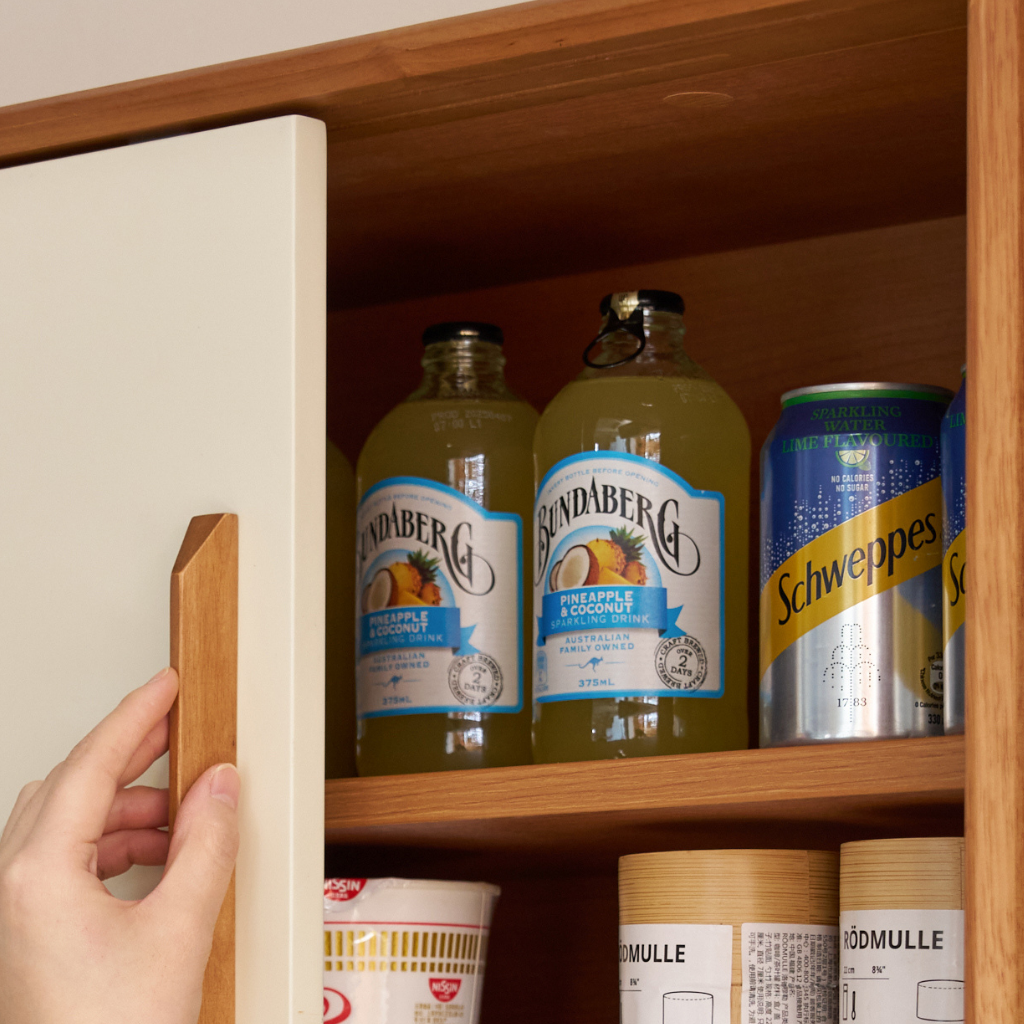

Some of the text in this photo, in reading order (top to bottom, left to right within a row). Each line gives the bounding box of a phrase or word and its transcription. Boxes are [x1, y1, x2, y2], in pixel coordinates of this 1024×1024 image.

[811, 405, 901, 421] SPARKLING
[824, 419, 886, 432] WATER
[782, 433, 933, 453] LIME FLAVOURED
[565, 469, 590, 481] BOTTLE
[625, 470, 659, 488] OPENING
[831, 474, 874, 483] NO CALORIES
[836, 483, 869, 492] NO SUGAR
[533, 475, 700, 586] BUNDABERG
[778, 513, 937, 625] Schweppes
[560, 591, 633, 605] PINEAPPLE
[561, 602, 633, 617] & COCONUT
[369, 611, 428, 627] PINEAPPLE
[551, 614, 649, 630] SPARKLING DRINK
[377, 623, 428, 637] COCONUT
[409, 634, 443, 642] DRINK
[565, 634, 630, 644] AUSTRALIAN
[559, 643, 634, 654] FAMILY OWNED
[676, 648, 693, 657] OVER
[373, 653, 425, 663] AUSTRALIAN
[679, 655, 687, 667] 2
[395, 662, 429, 670] OWNED
[671, 666, 692, 677] DAYS
[472, 673, 481, 683] 2
[464, 683, 486, 692] DAYS
[928, 714, 940, 724] 330
[844, 925, 944, 950] RÖDMULLE
[797, 944, 802, 954] GB
[432, 980, 458, 994] NISSIN
[766, 1017, 772, 1024] 22
